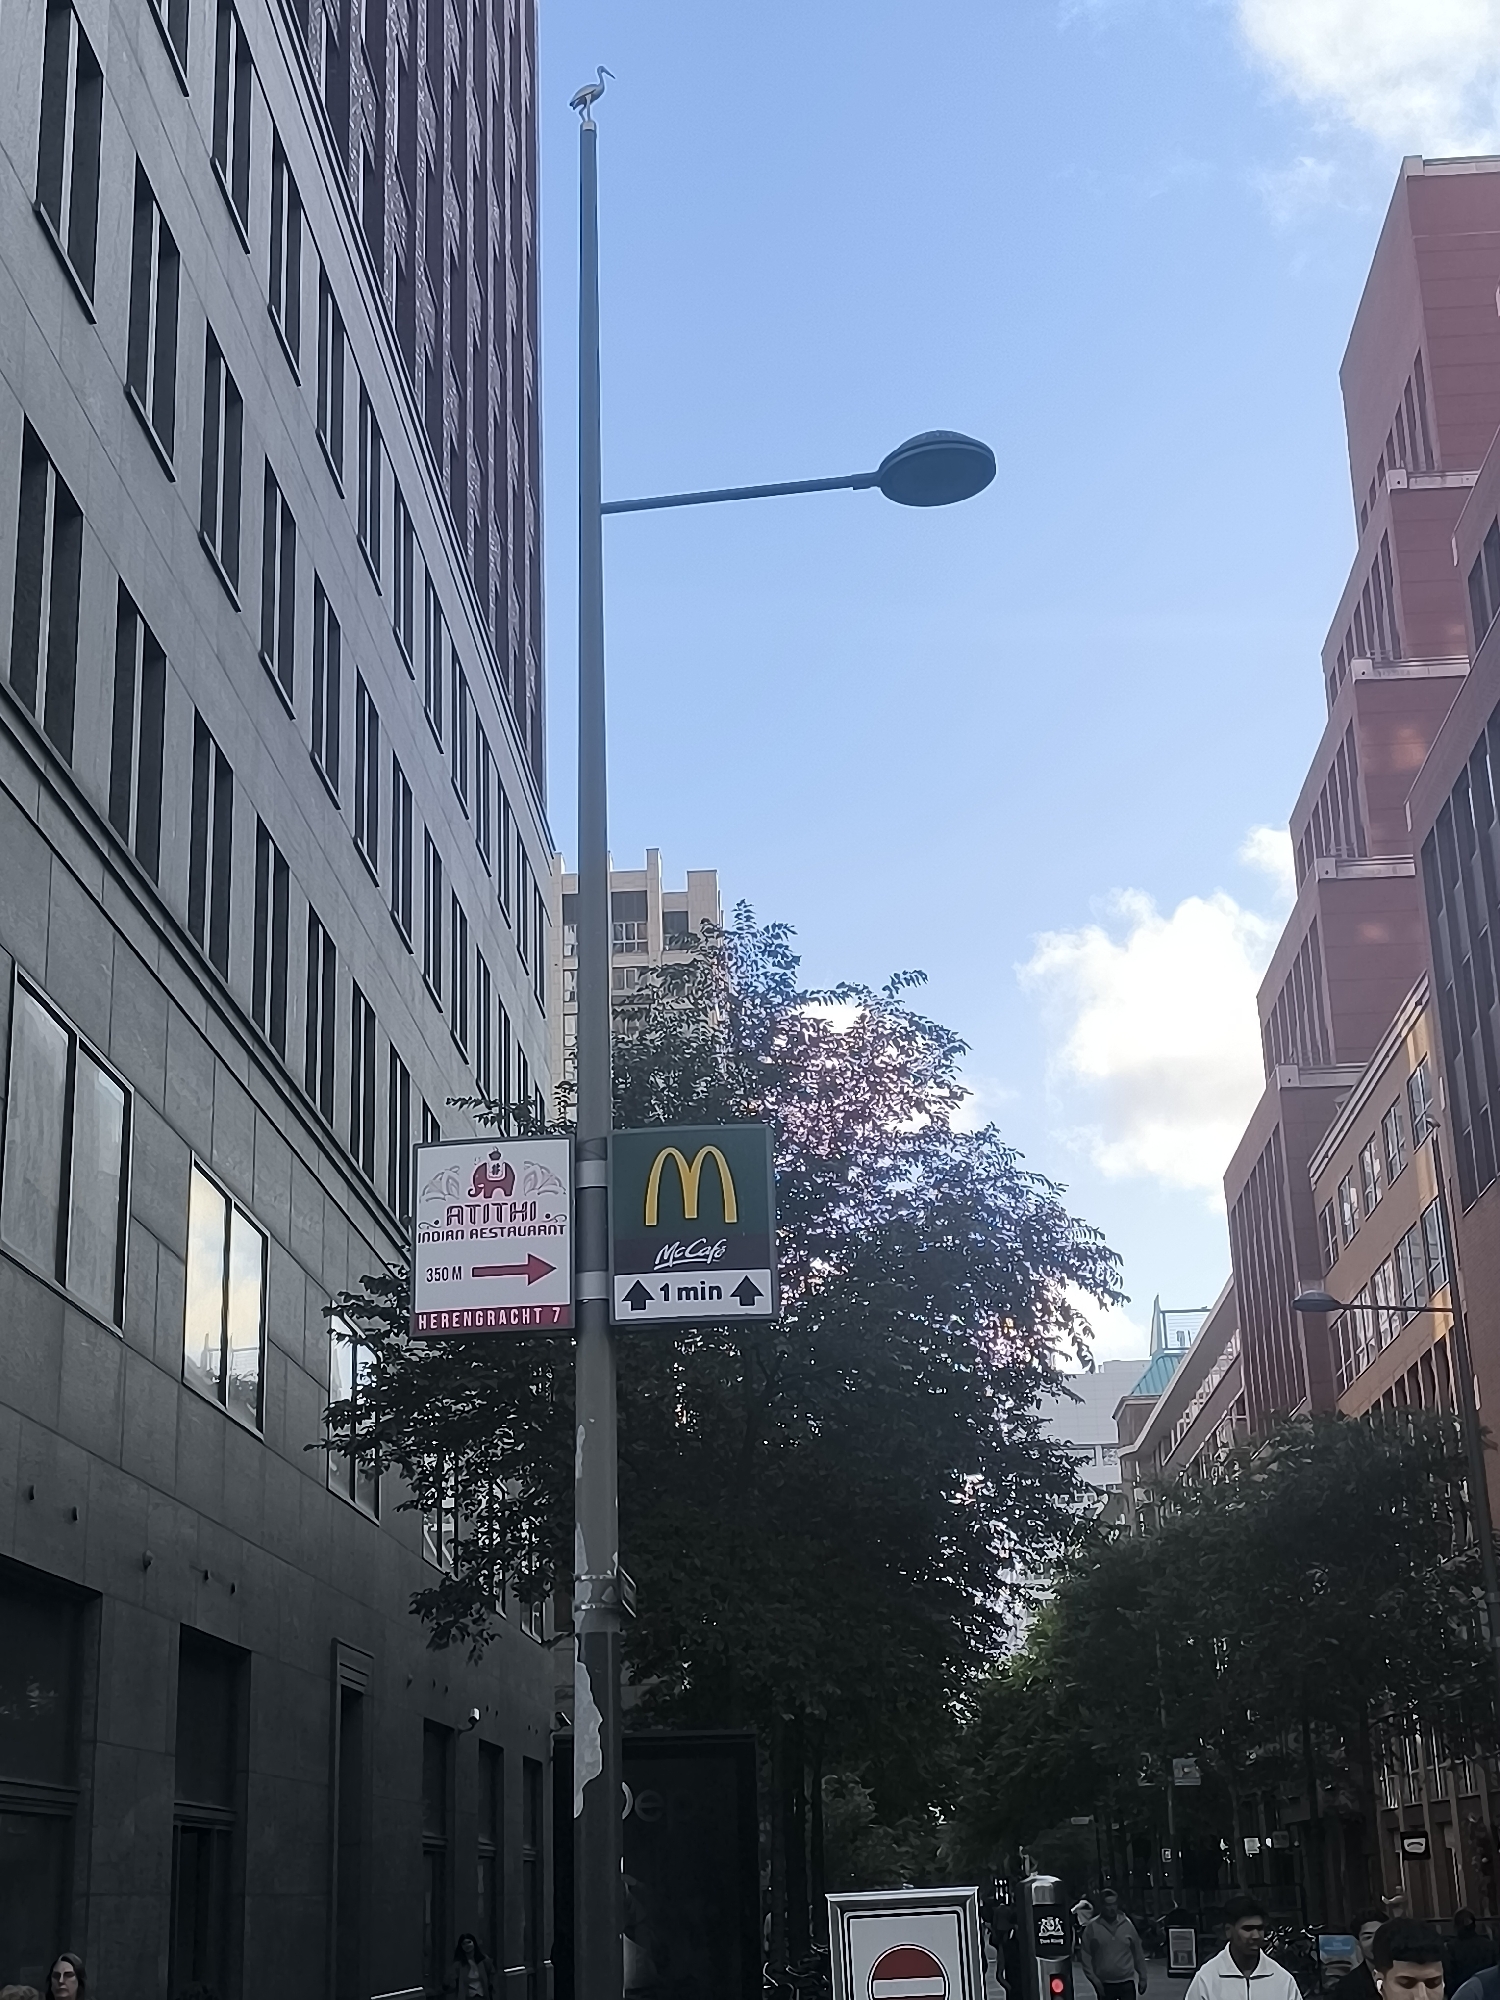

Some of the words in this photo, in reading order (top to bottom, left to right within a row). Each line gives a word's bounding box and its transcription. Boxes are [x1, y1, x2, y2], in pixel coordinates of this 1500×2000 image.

[446, 1201, 537, 1226] ATITHI
[417, 1229, 465, 1243] INDIAN
[469, 1225, 566, 1239] RESTAURANT
[426, 1266, 449, 1282] 350
[452, 1265, 462, 1281] M
[659, 1282, 670, 1302] 1
[677, 1280, 723, 1301] min
[418, 1307, 543, 1330] HERENGRACHT
[552, 1306, 561, 1323] 7
